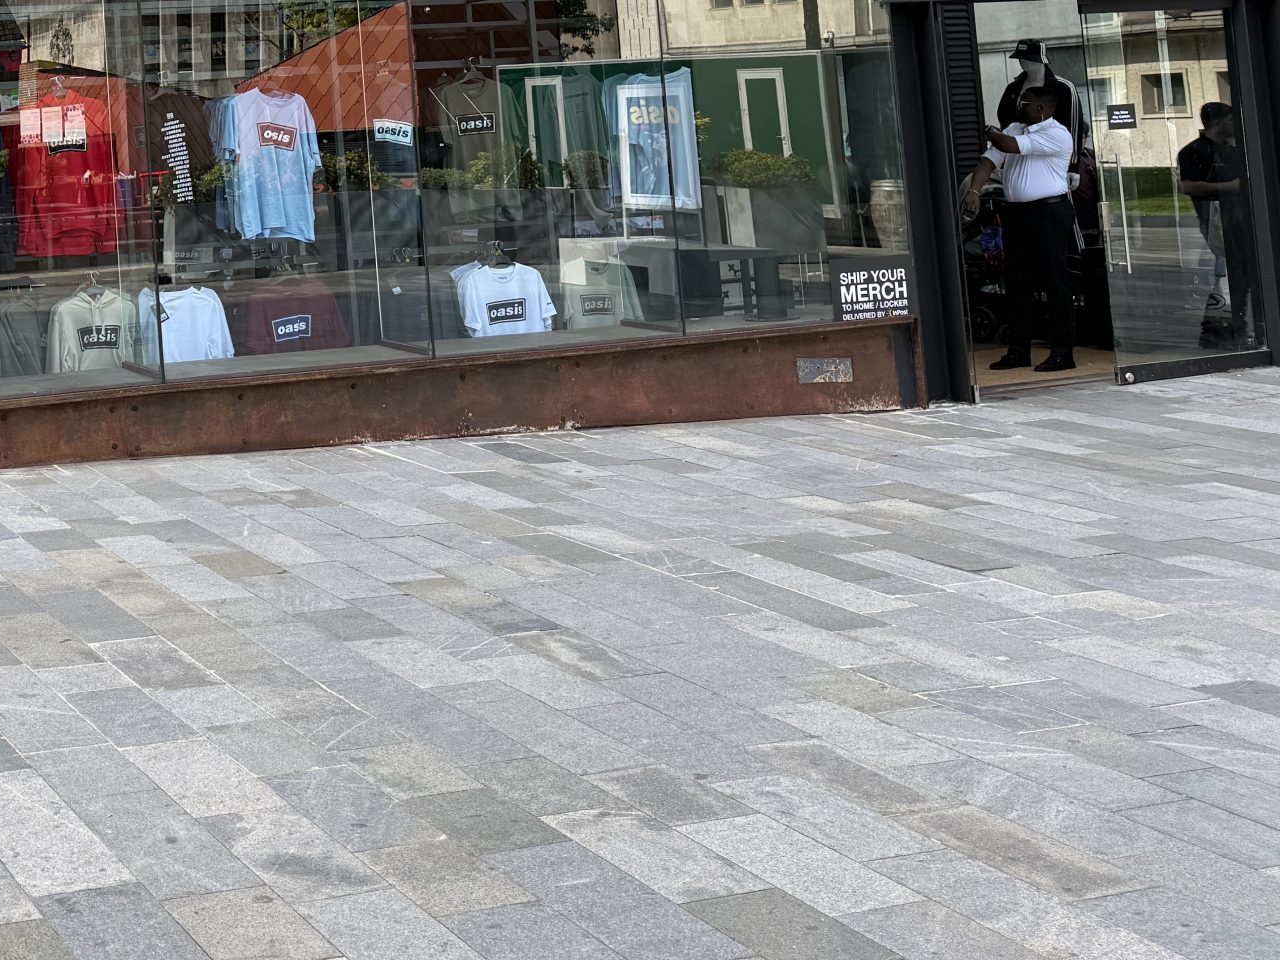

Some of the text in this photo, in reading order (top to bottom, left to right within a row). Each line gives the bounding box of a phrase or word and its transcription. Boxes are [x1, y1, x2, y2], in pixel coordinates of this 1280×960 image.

[460, 117, 492, 130] oasis
[264, 130, 290, 143] osis
[377, 125, 409, 138] oasis
[840, 269, 906, 285] SHIP YOUR
[840, 281, 908, 303] MERCH
[490, 304, 522, 318] oasis
[853, 302, 874, 311] HOME
[880, 299, 908, 309] LOCKER
[842, 311, 876, 321] DELIVERED
[84, 330, 117, 343] oasis
